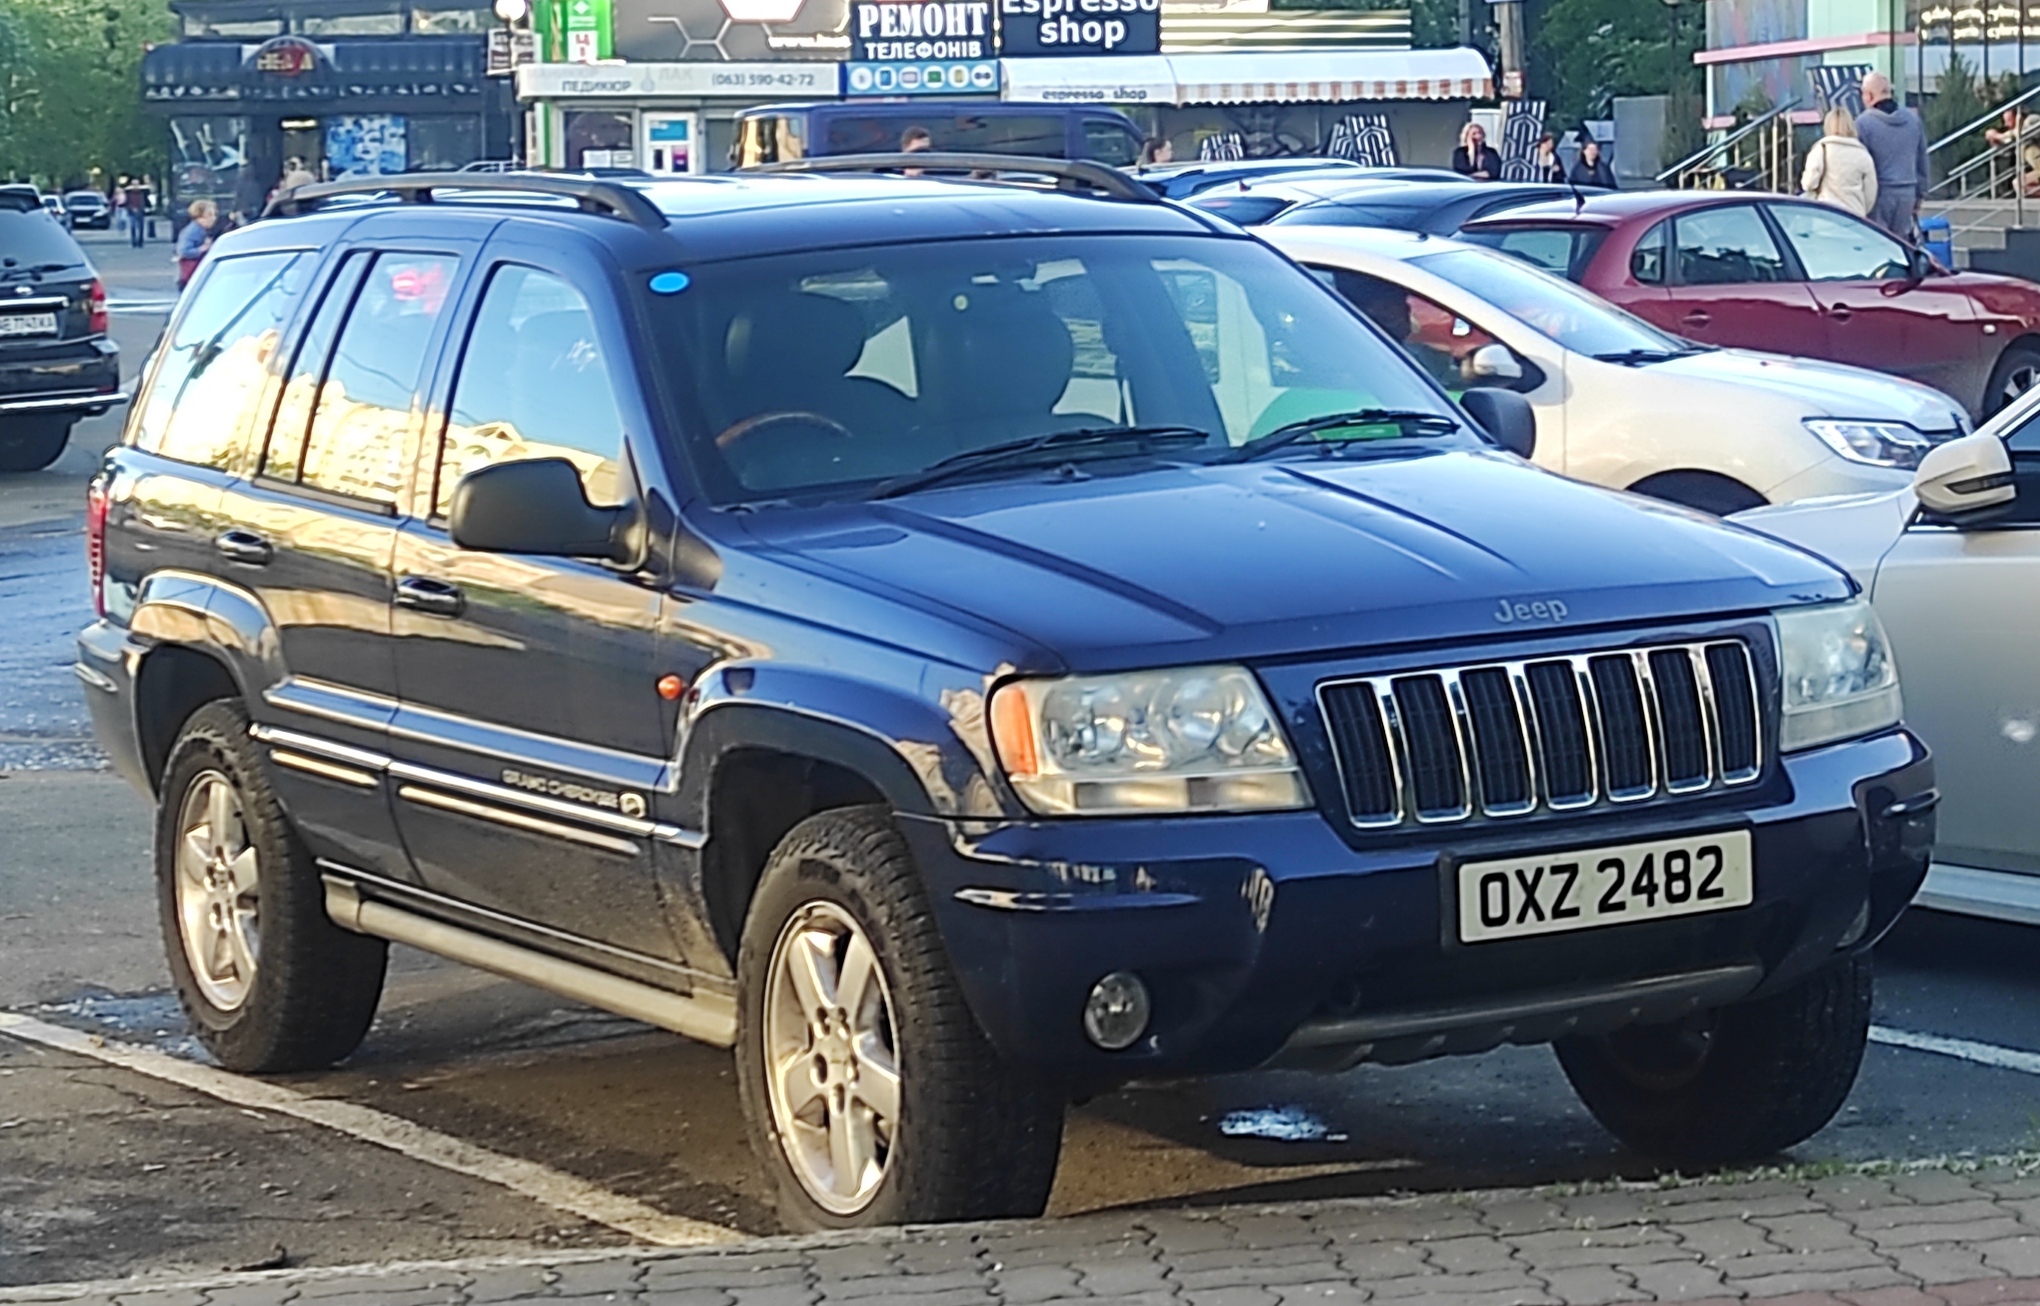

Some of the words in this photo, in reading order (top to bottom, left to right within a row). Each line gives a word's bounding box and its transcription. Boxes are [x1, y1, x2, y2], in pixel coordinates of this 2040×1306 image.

[858, 3, 988, 37] РЕМОНТ
[1040, 15, 1125, 49] shop
[864, 41, 982, 59] ТЕЛЕФОНІВ
[712, 73, 745, 86] (063)
[1042, 90, 1105, 102] espresso
[1113, 86, 1147, 101] shop
[1494, 599, 1568, 623] Jeep
[1479, 863, 1580, 928] OXZ
[1597, 845, 1724, 914] 2482
